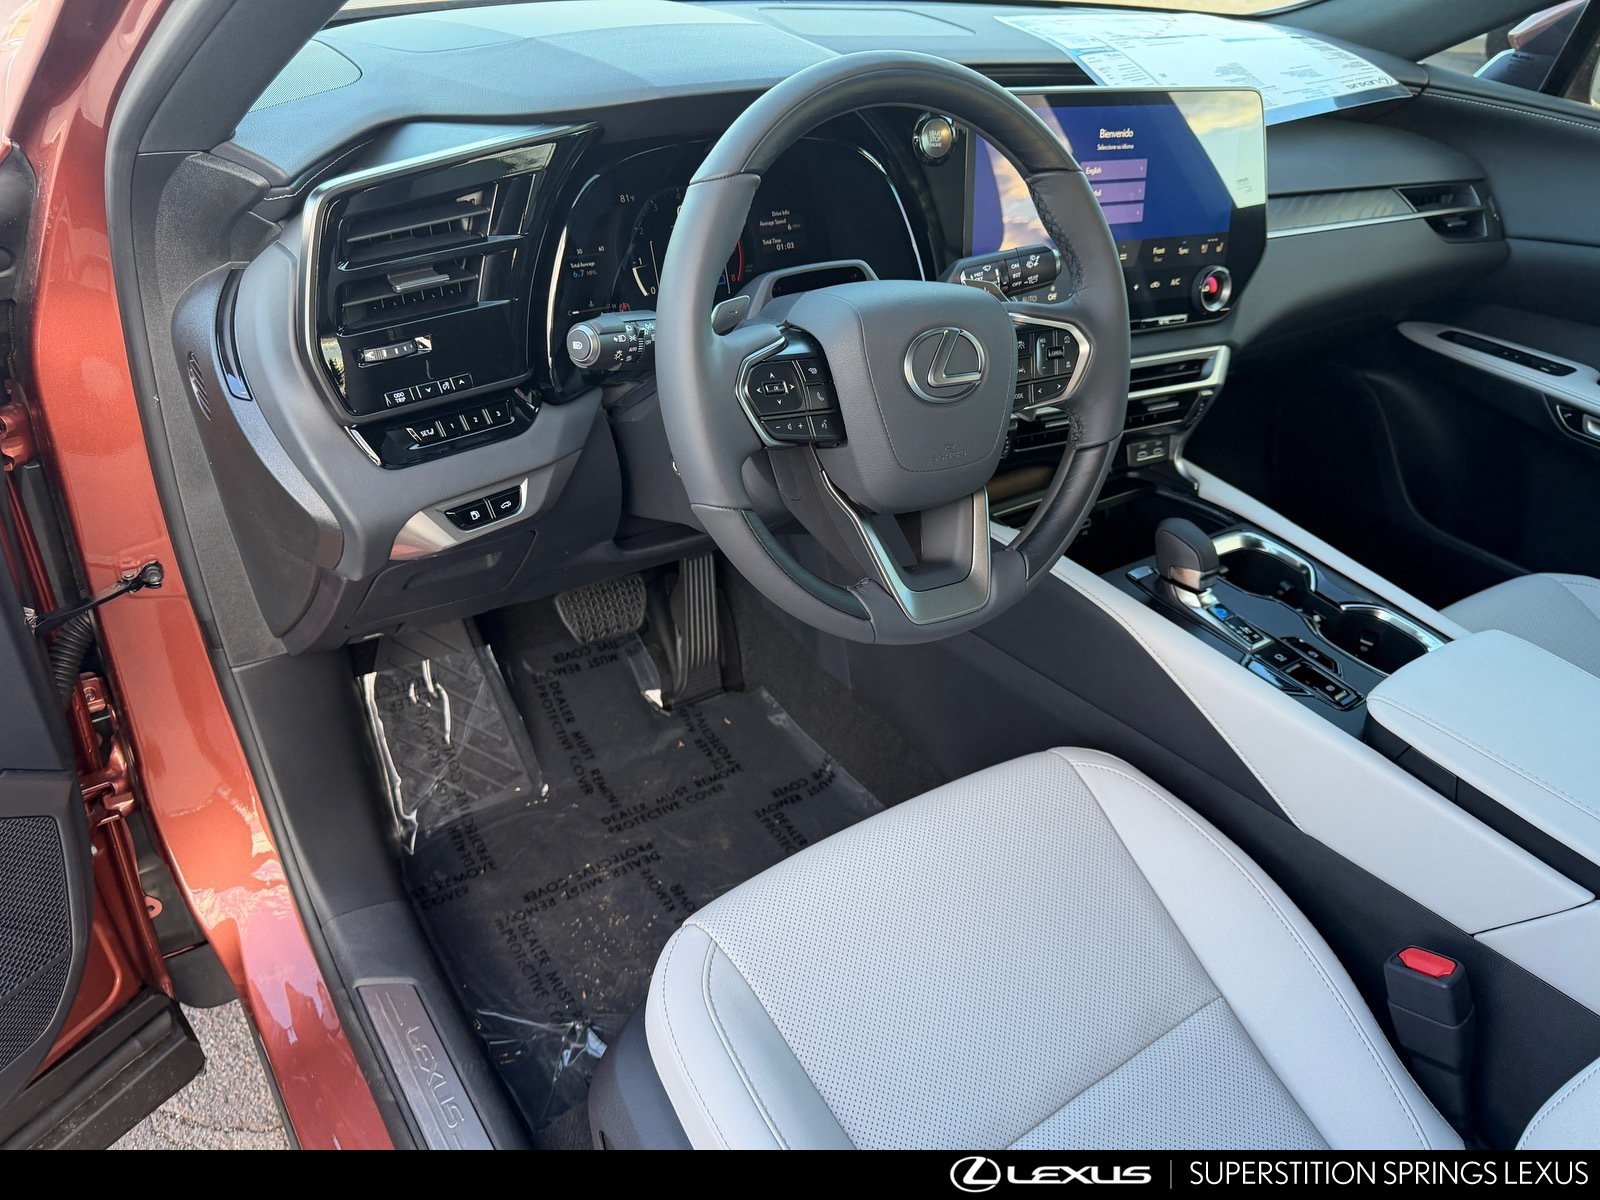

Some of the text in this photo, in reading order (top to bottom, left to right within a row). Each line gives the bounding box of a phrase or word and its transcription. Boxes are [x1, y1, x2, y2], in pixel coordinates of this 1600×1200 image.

[1099, 128, 1134, 139] Bienvenido
[1085, 166, 1102, 176] English
[776, 243, 795, 251] 01:03
[638, 257, 643, 265] 1
[573, 270, 584, 278] 6.7
[650, 286, 656, 295] 0
[553, 646, 590, 663] COVER
[588, 653, 617, 667] MUST
[536, 685, 592, 795] PROTECTIVE COVER
[549, 681, 620, 810] DEALER MUST REMOVE
[600, 763, 744, 825] DEALER MUST REMOVE
[770, 777, 808, 798] COVER
[607, 782, 725, 834] PROTECTIVE COVER
[448, 826, 473, 866] DEALER
[612, 851, 659, 877] DEALER
[522, 878, 567, 902] COVER
[564, 877, 601, 899] MUST
[641, 868, 674, 911] REMOVE
[670, 883, 694, 911] OVER
[502, 929, 547, 999] PROTECTIVE
[519, 922, 549, 965] DEALER
[547, 972, 573, 1005] MUST
[407, 1026, 465, 1128] LEXUS
